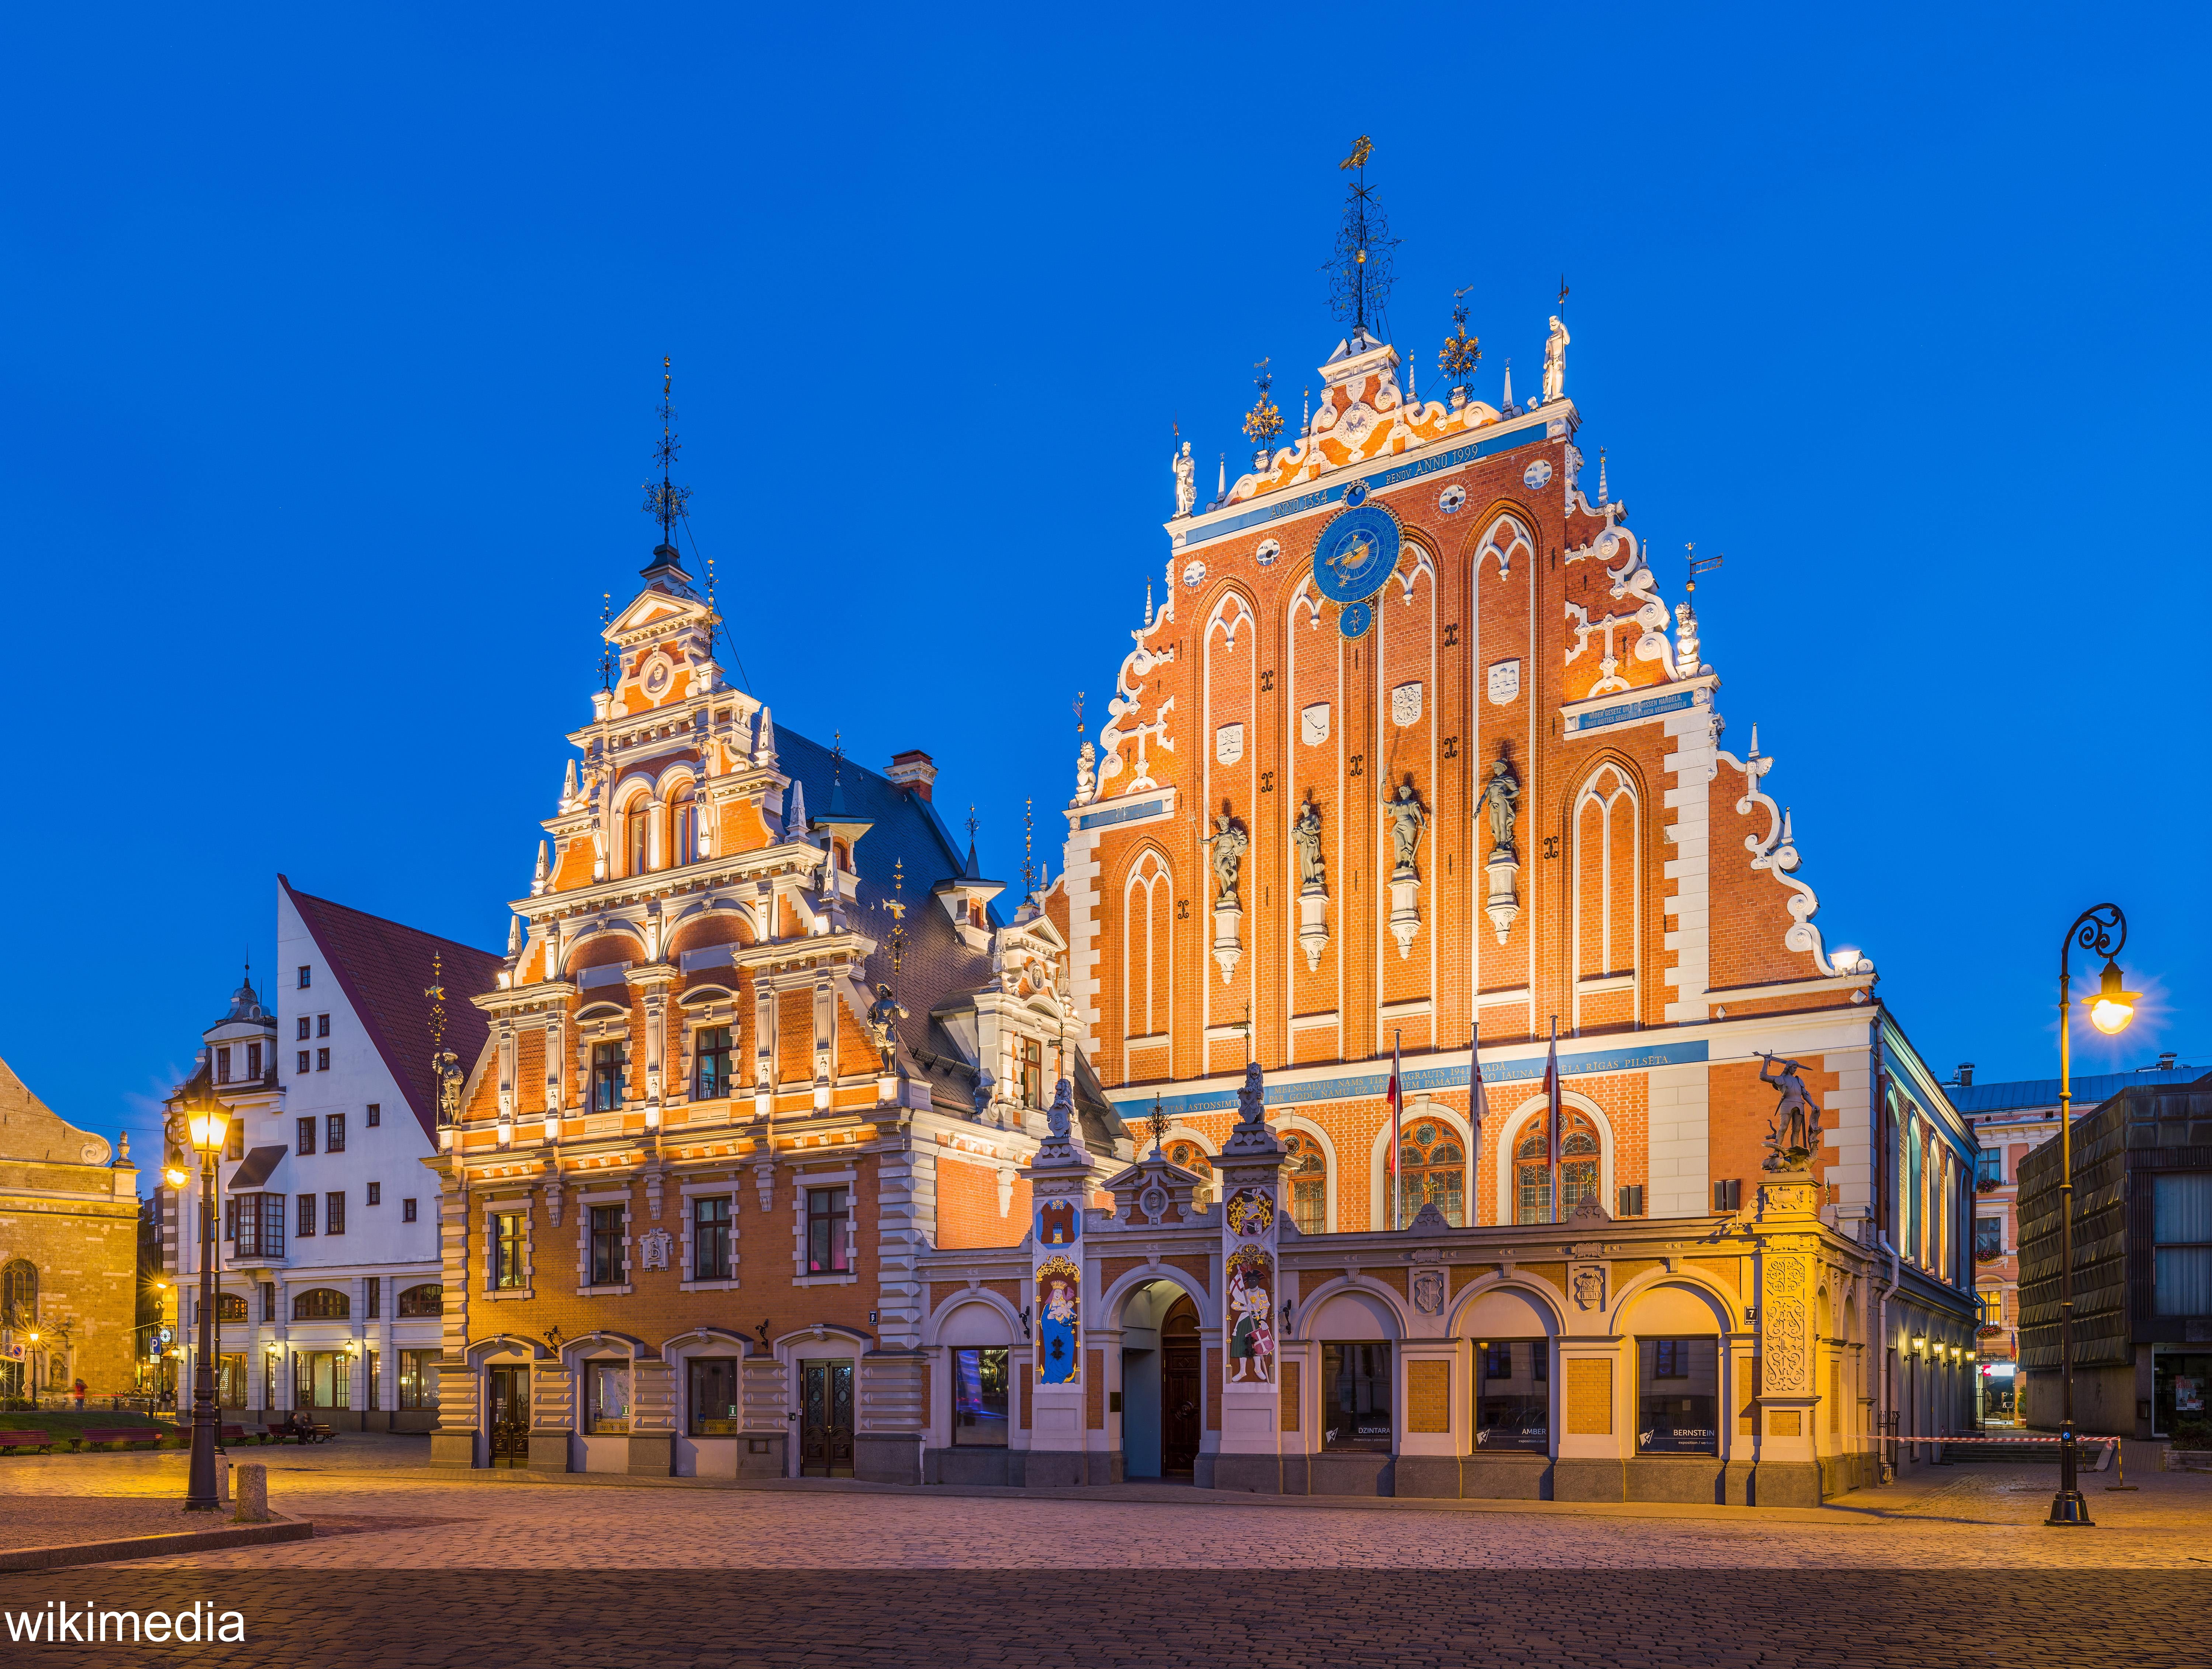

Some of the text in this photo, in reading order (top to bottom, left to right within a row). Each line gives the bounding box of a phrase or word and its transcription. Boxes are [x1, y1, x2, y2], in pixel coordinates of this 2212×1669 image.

[1414, 454, 1448, 476] ANNO
[1452, 444, 1478, 465] 1999
[1269, 490, 1328, 519] ANNO 1334
[1585, 719, 1598, 728] THUT
[1598, 716, 1614, 725] GOTTES
[1655, 701, 1687, 713] VERWANDELN
[1605, 707, 1621, 716] GESETZ
[1274, 1081, 1333, 1094] MELNGALVJU
[1338, 1078, 1363, 1087] NAMS
[1368, 1076, 1390, 1084] TIKA
[1401, 1070, 1444, 1081] AGRAUTS
[1290, 1091, 1317, 1101] GODU
[1321, 1089, 1349, 1098] NAMU
[1502, 1069, 1534, 1081] JAUNA
[1586, 1061, 1619, 1070] RĪGAS
[1625, 1056, 1671, 1068] PILSĒTA.
[152, 1339, 158, 1352] P
